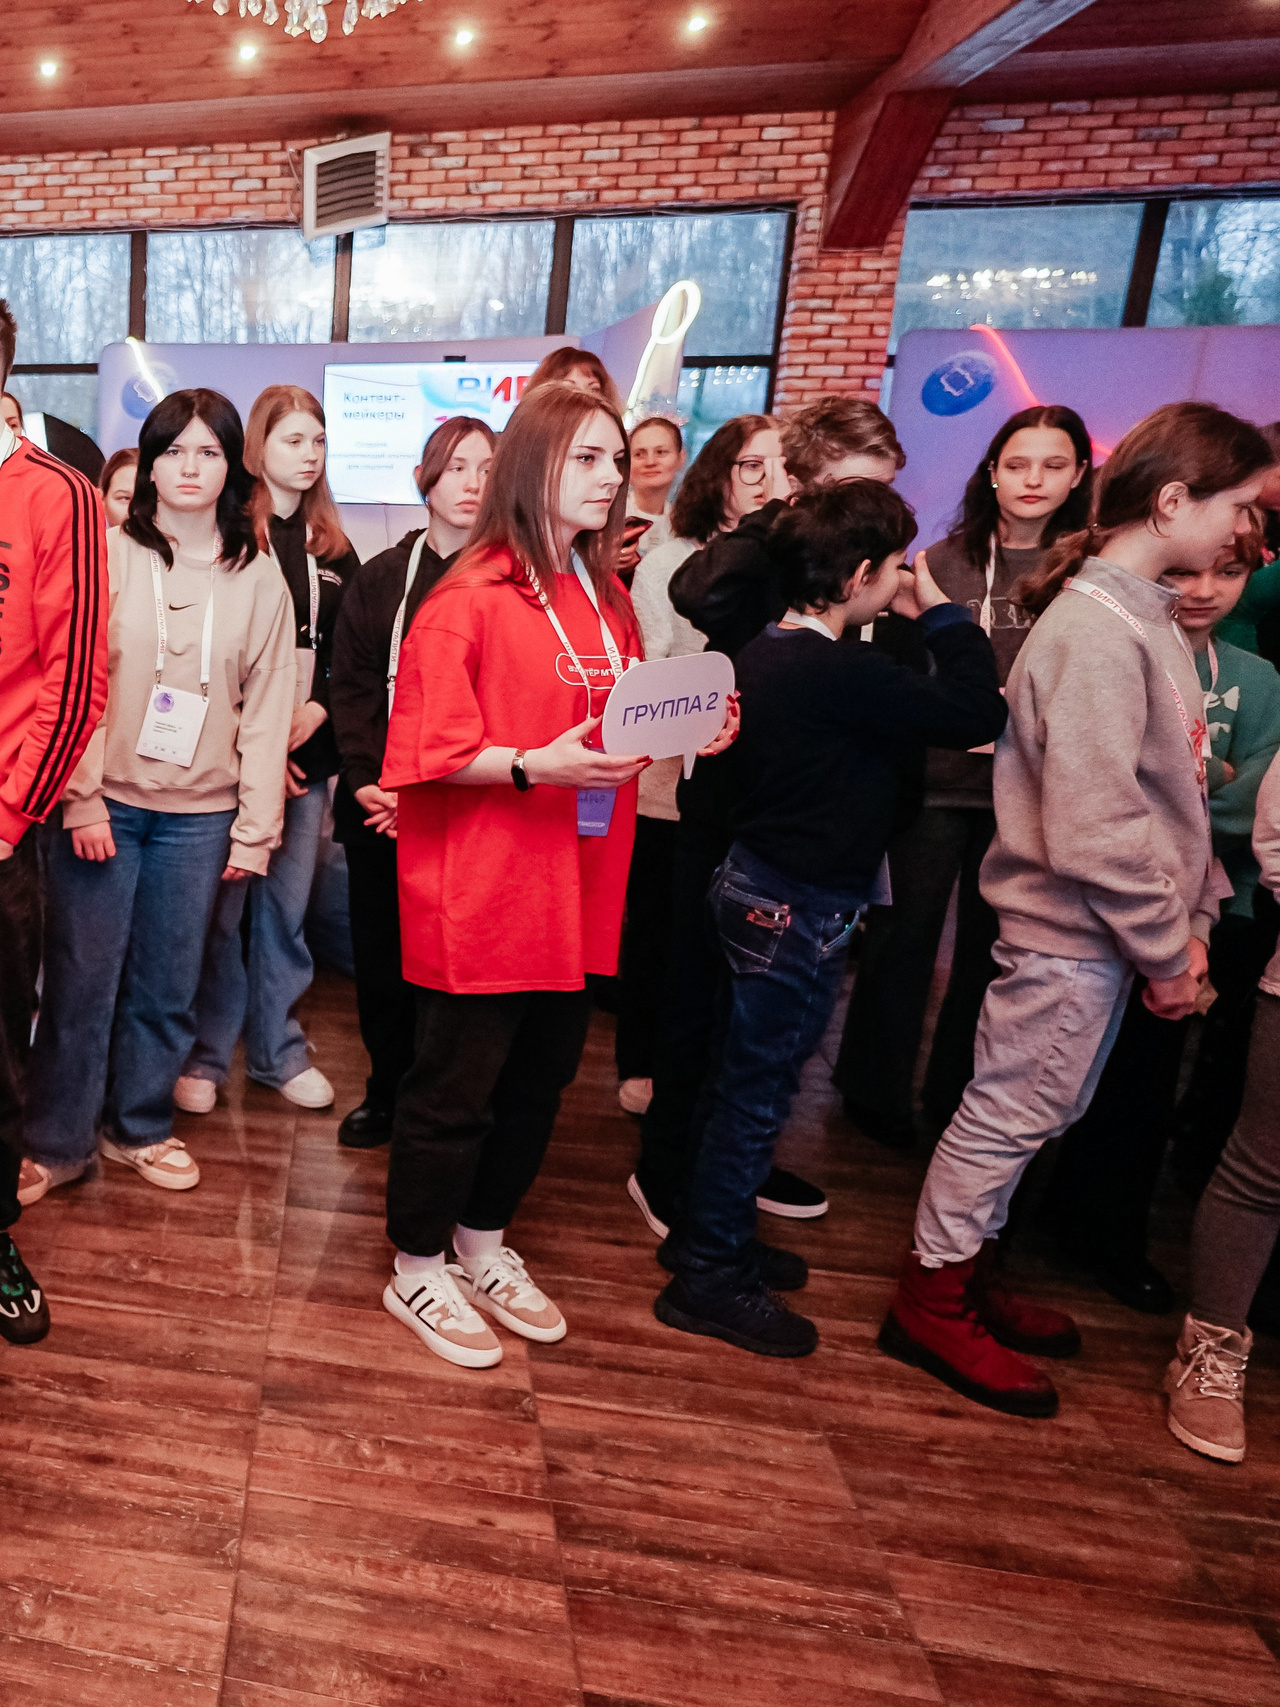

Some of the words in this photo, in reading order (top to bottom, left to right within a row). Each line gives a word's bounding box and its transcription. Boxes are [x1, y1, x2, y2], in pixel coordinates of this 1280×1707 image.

[343, 392, 406, 404] Контент-
[343, 408, 406, 421] мейкеры
[622, 695, 702, 727] ГРУППА
[706, 692, 719, 711] 2
